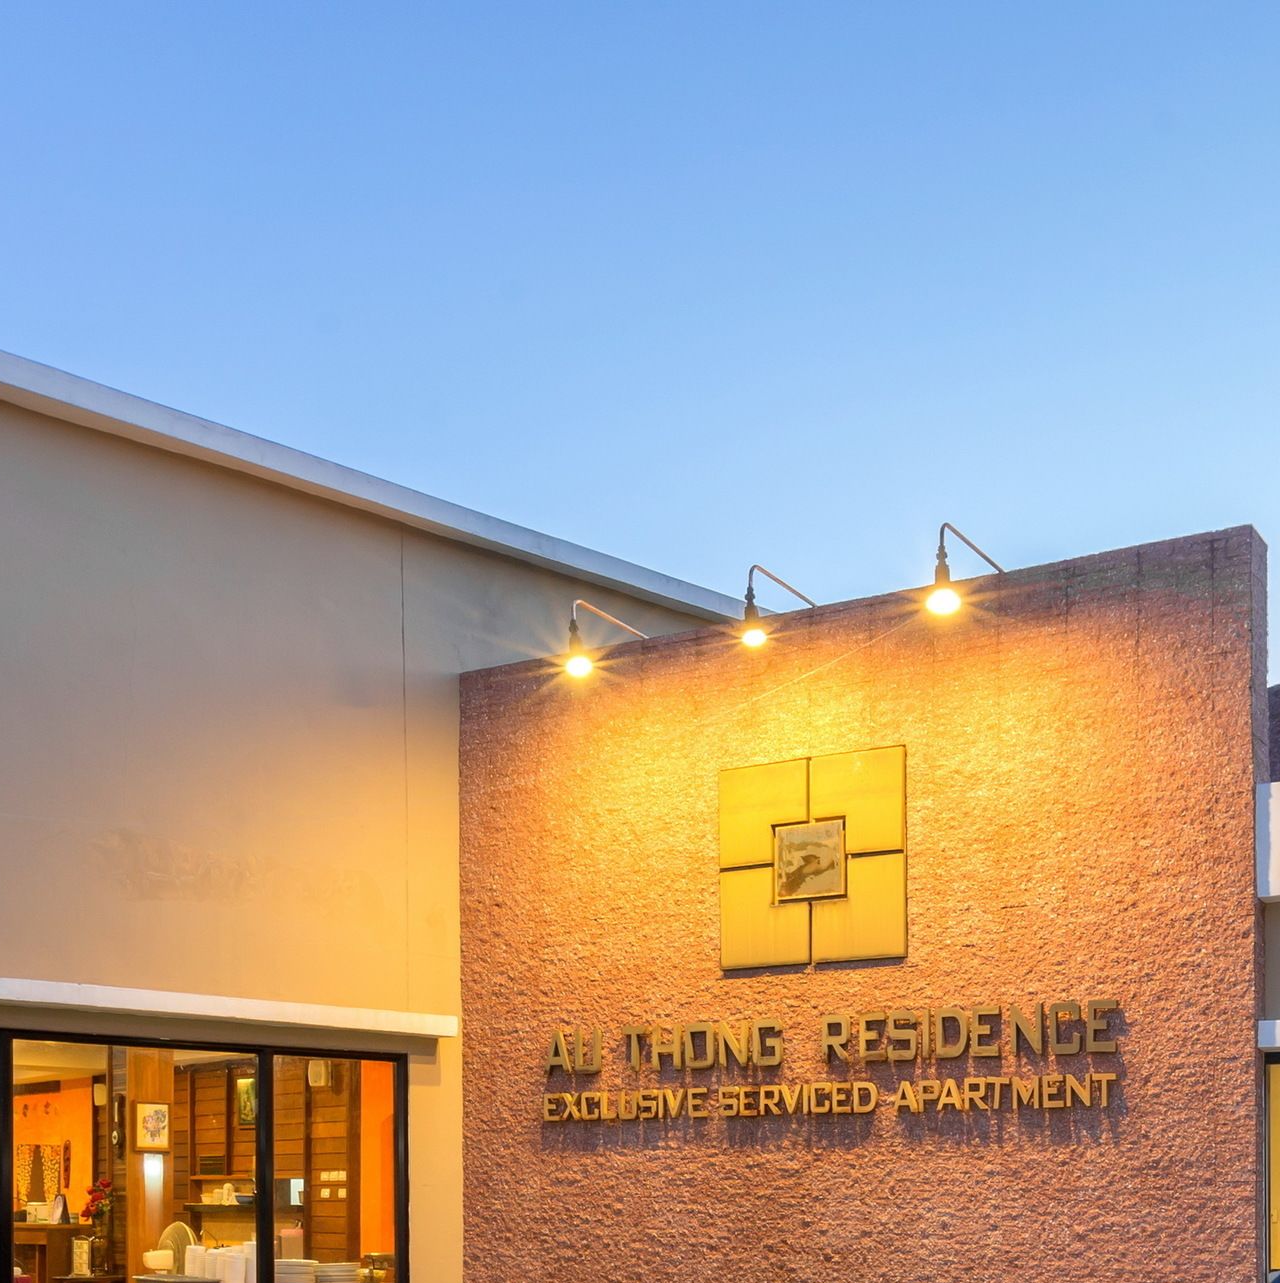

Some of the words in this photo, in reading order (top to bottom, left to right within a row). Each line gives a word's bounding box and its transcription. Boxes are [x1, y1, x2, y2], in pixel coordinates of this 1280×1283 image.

[544, 1025, 603, 1075] AU
[622, 1018, 784, 1072] THONG
[821, 999, 1119, 1064] RESIDENCE
[543, 1087, 710, 1122] EXCLUSIVE
[718, 1081, 879, 1117] SERVICED
[893, 1072, 1117, 1114] APARTMENT
